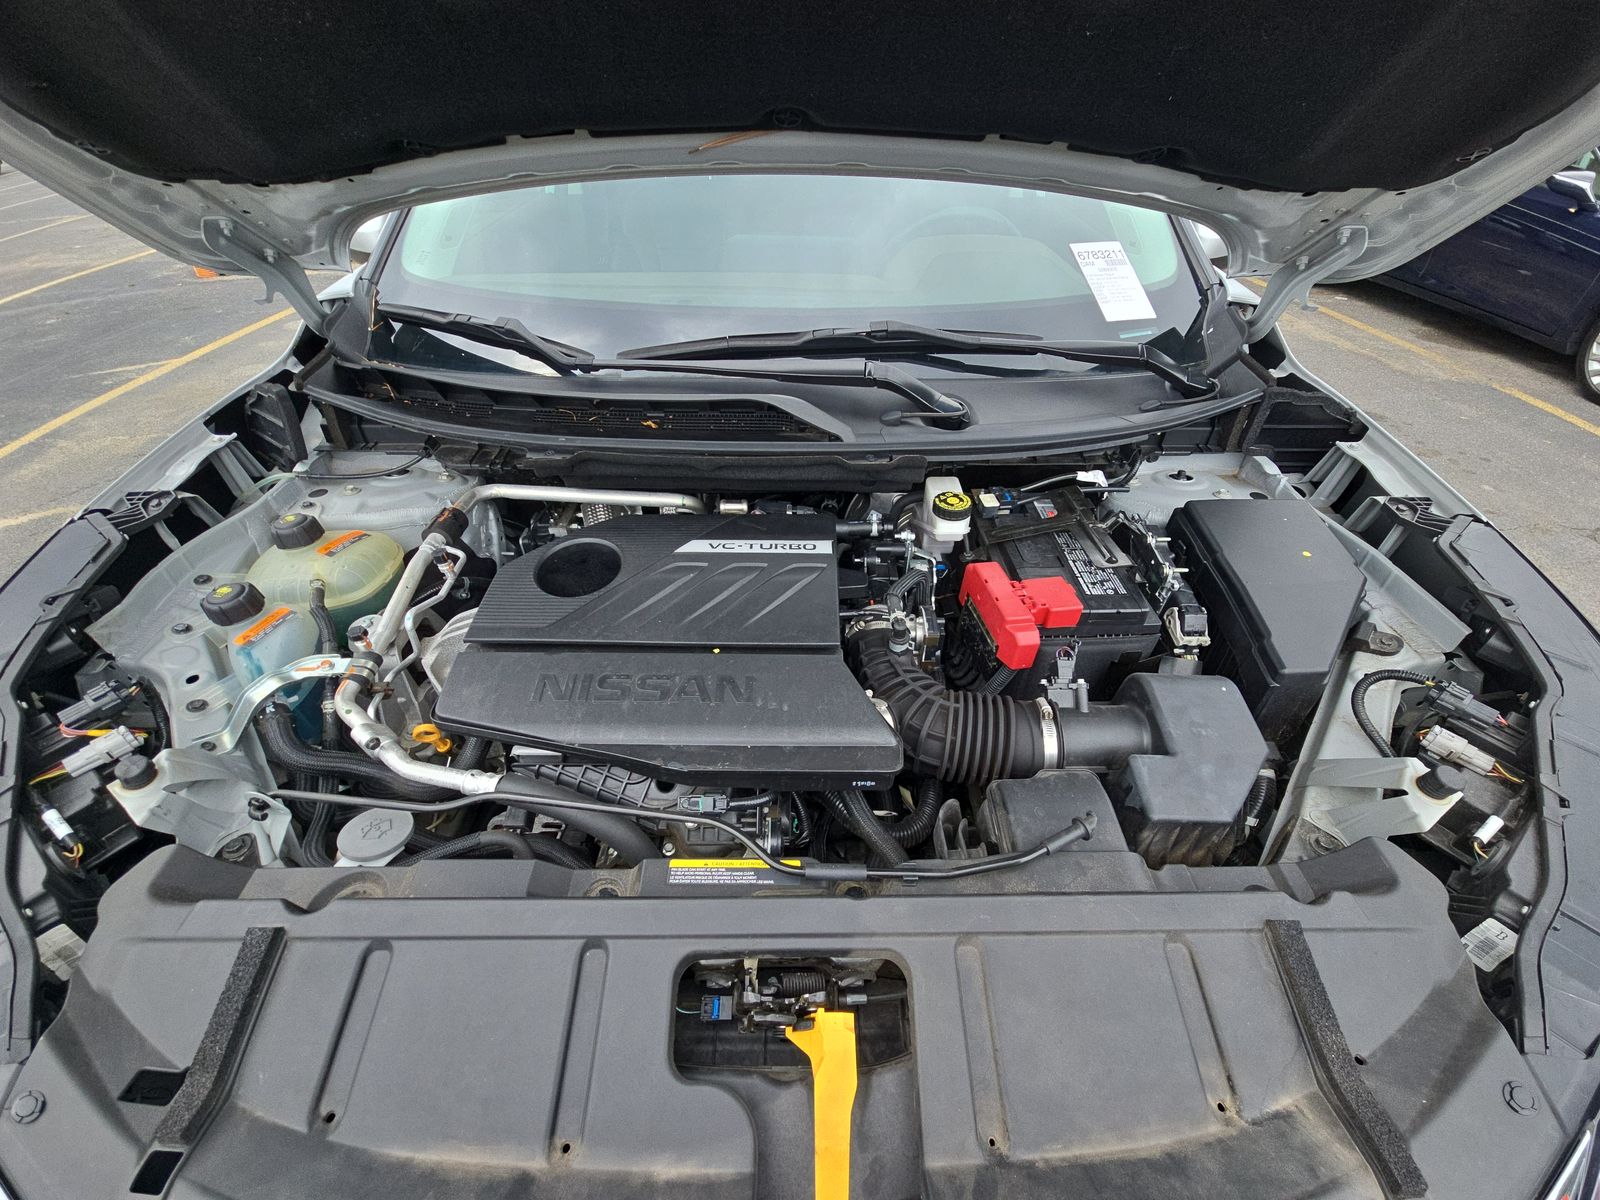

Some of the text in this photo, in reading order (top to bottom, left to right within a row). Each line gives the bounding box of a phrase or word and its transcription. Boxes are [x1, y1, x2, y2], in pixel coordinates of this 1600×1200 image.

[1077, 249, 1125, 261] 6783211
[708, 542, 817, 551] VC-TURBO
[530, 672, 755, 704] NISSAN
